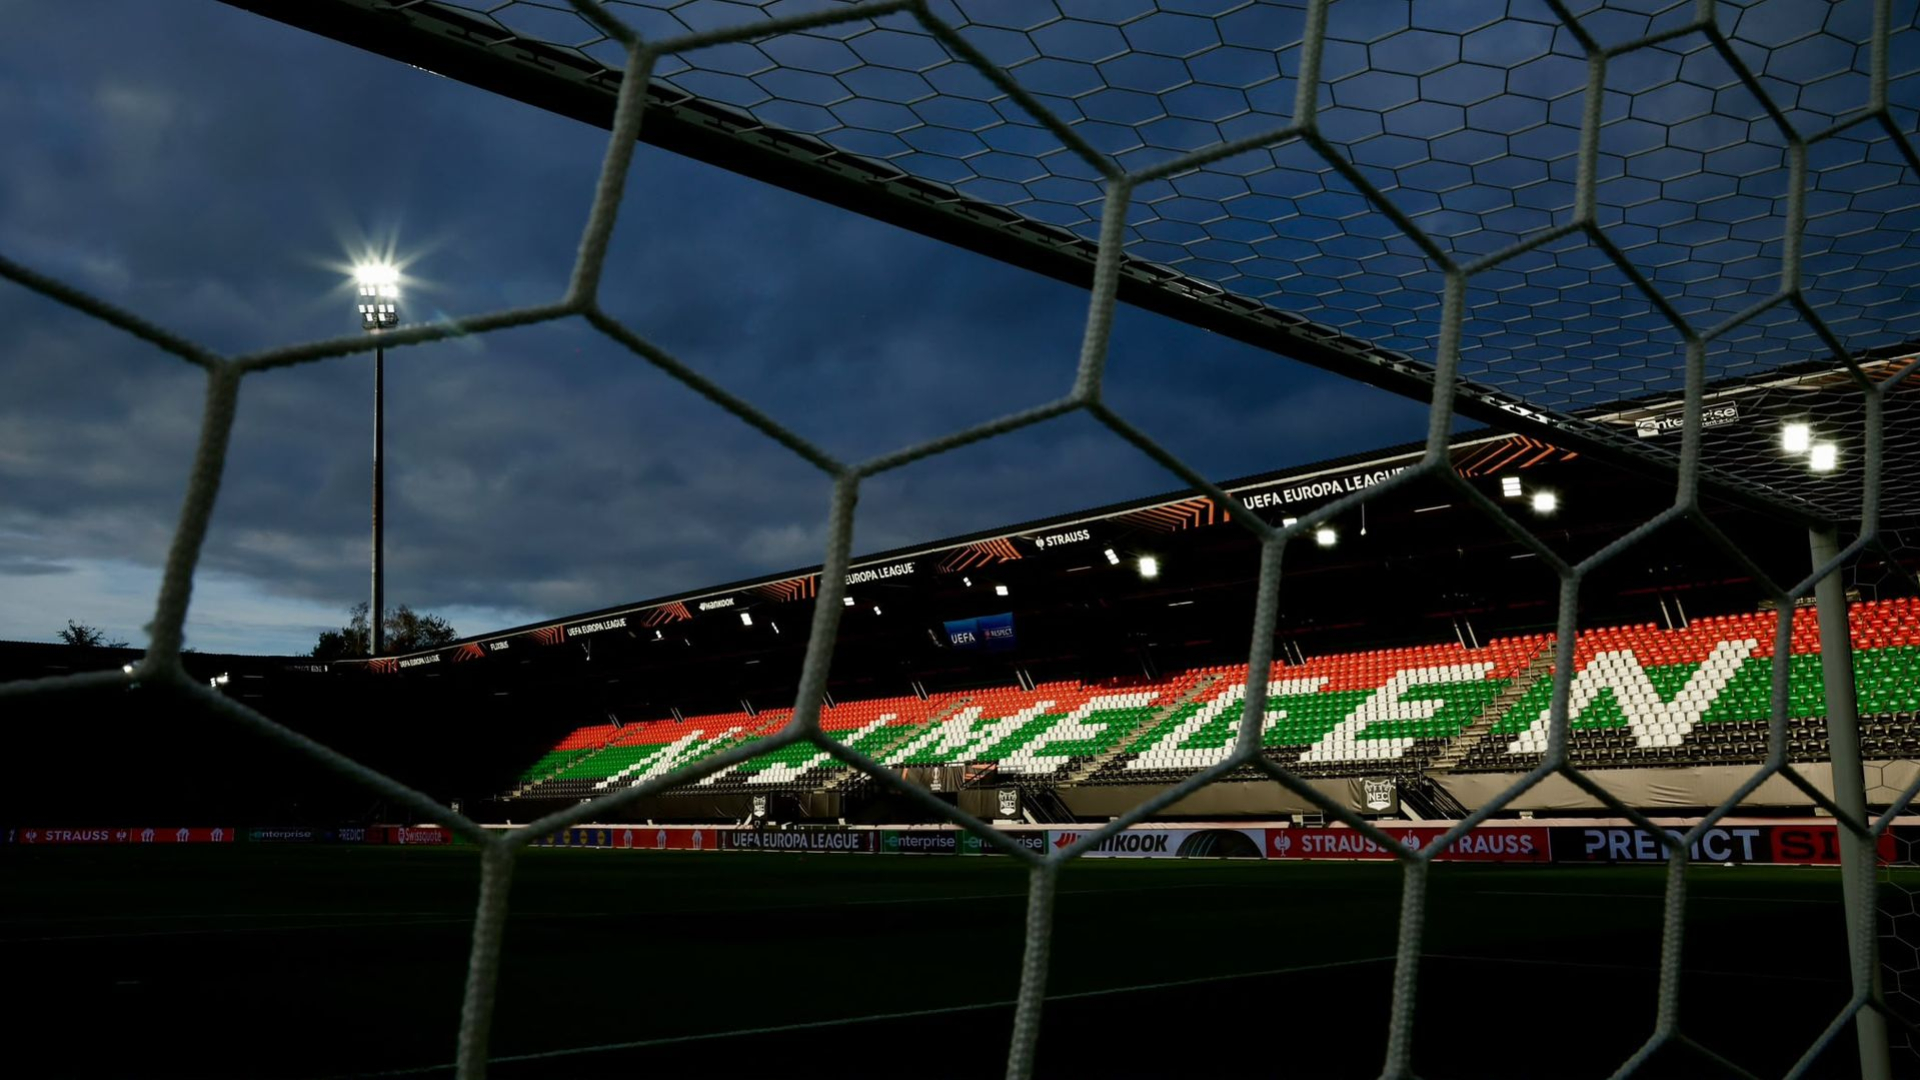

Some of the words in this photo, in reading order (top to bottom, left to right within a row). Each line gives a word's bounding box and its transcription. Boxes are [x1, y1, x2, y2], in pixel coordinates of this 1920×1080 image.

[1243, 491, 1282, 510] UEFA
[1283, 480, 1343, 503] EUROPA
[1046, 529, 1090, 547] STRAUSS
[845, 570, 879, 585] EUROPA
[878, 562, 914, 579] LEAGUE
[567, 626, 582, 636] UEFA
[581, 622, 604, 634] EUROPA
[603, 617, 627, 630] LEAGUE
[951, 632, 976, 644] UEFA
[1369, 792, 1389, 801] NEC
[45, 830, 110, 841] STRAUSS
[732, 832, 760, 847] UEFA
[763, 833, 808, 848] EUROPA
[811, 833, 859, 849] LEAGUE
[886, 834, 955, 850] enterprise
